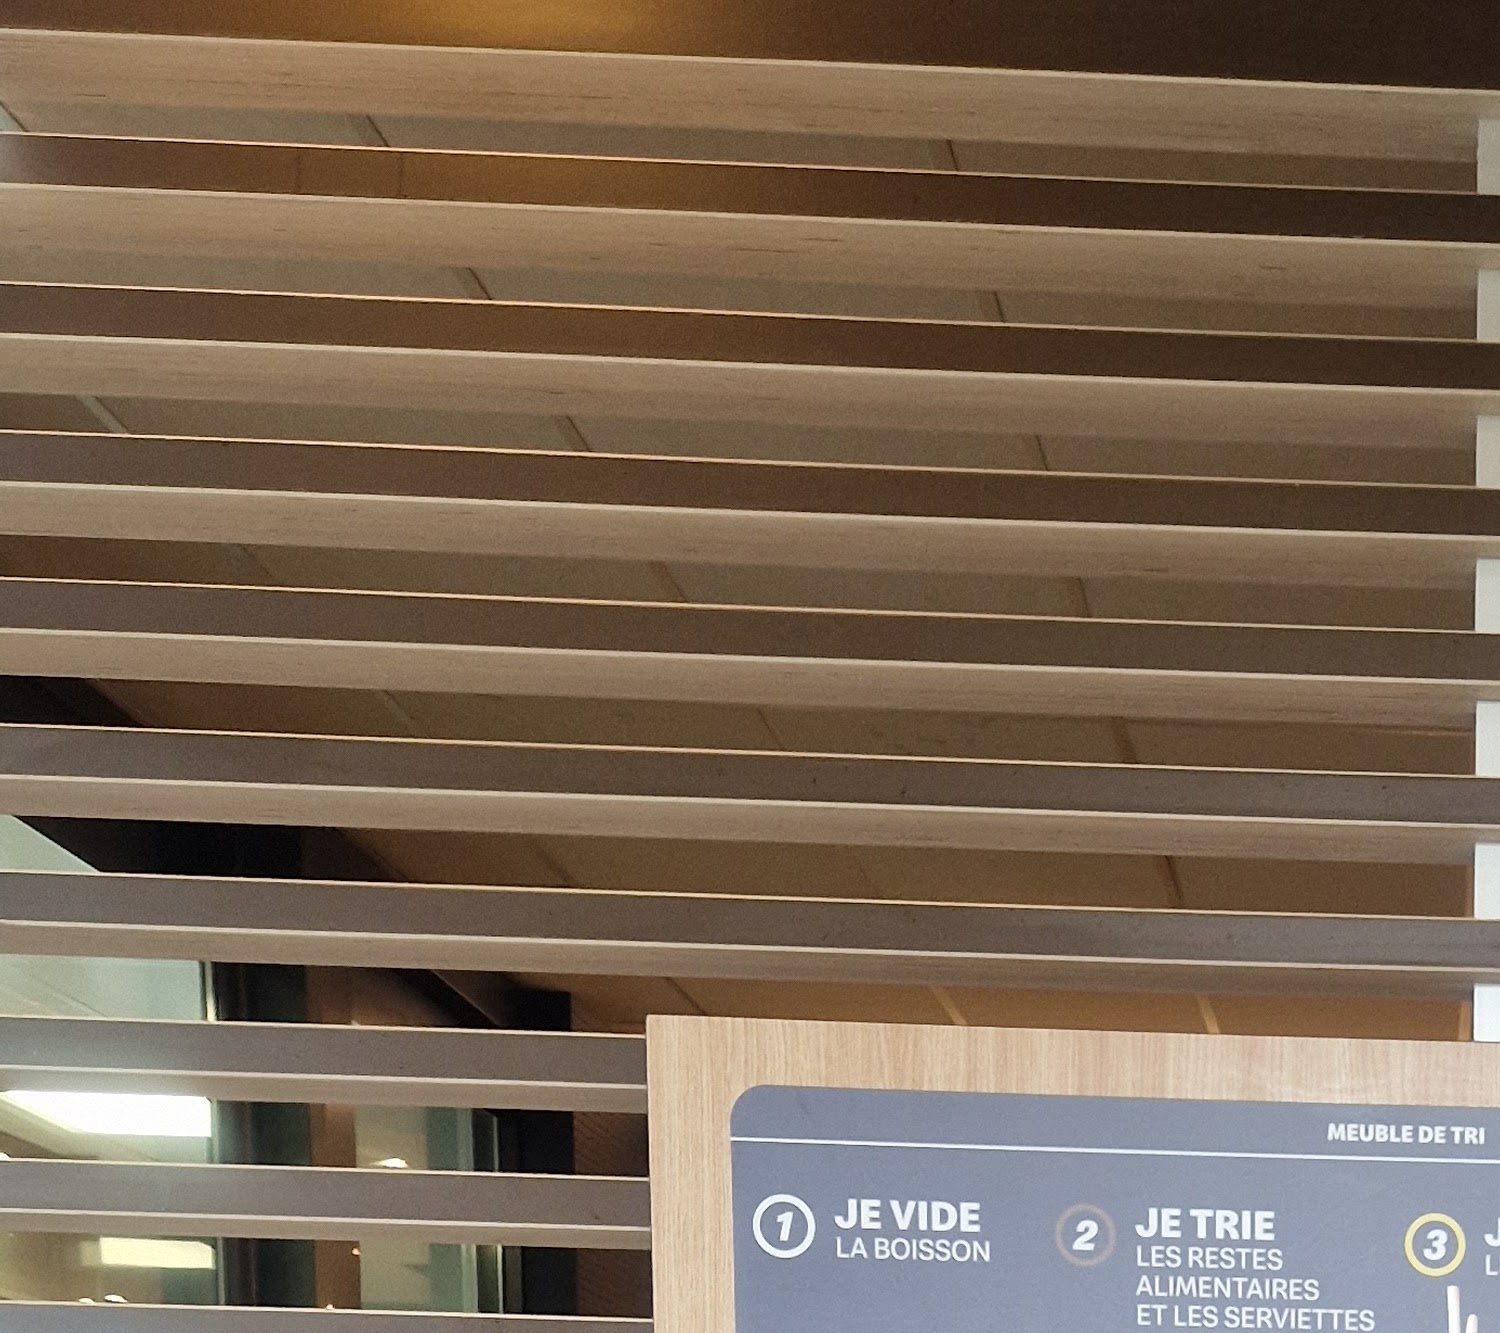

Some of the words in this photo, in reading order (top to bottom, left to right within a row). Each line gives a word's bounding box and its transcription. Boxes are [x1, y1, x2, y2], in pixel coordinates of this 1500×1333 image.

[1328, 1123, 1413, 1142] MEUBLE
[1419, 1126, 1446, 1143] DE
[1450, 1127, 1484, 1144] TRI
[777, 1212, 793, 1241] 1
[835, 1199, 881, 1229] JE
[890, 1200, 980, 1232] VIDE
[1135, 1208, 1181, 1237] JE
[1190, 1209, 1275, 1240] TRIE
[1073, 1220, 1098, 1250] 2
[1423, 1230, 1447, 1260] 3
[837, 1237, 867, 1258] LA
[875, 1238, 990, 1262] BOISSON
[1137, 1245, 1180, 1267] LES
[1188, 1247, 1283, 1270] RESTES
[1136, 1275, 1319, 1300] ALIMENTAIRES
[1137, 1304, 1167, 1325] ET
[1175, 1305, 1218, 1327] LES
[1224, 1306, 1375, 1331] SERVIETTES
